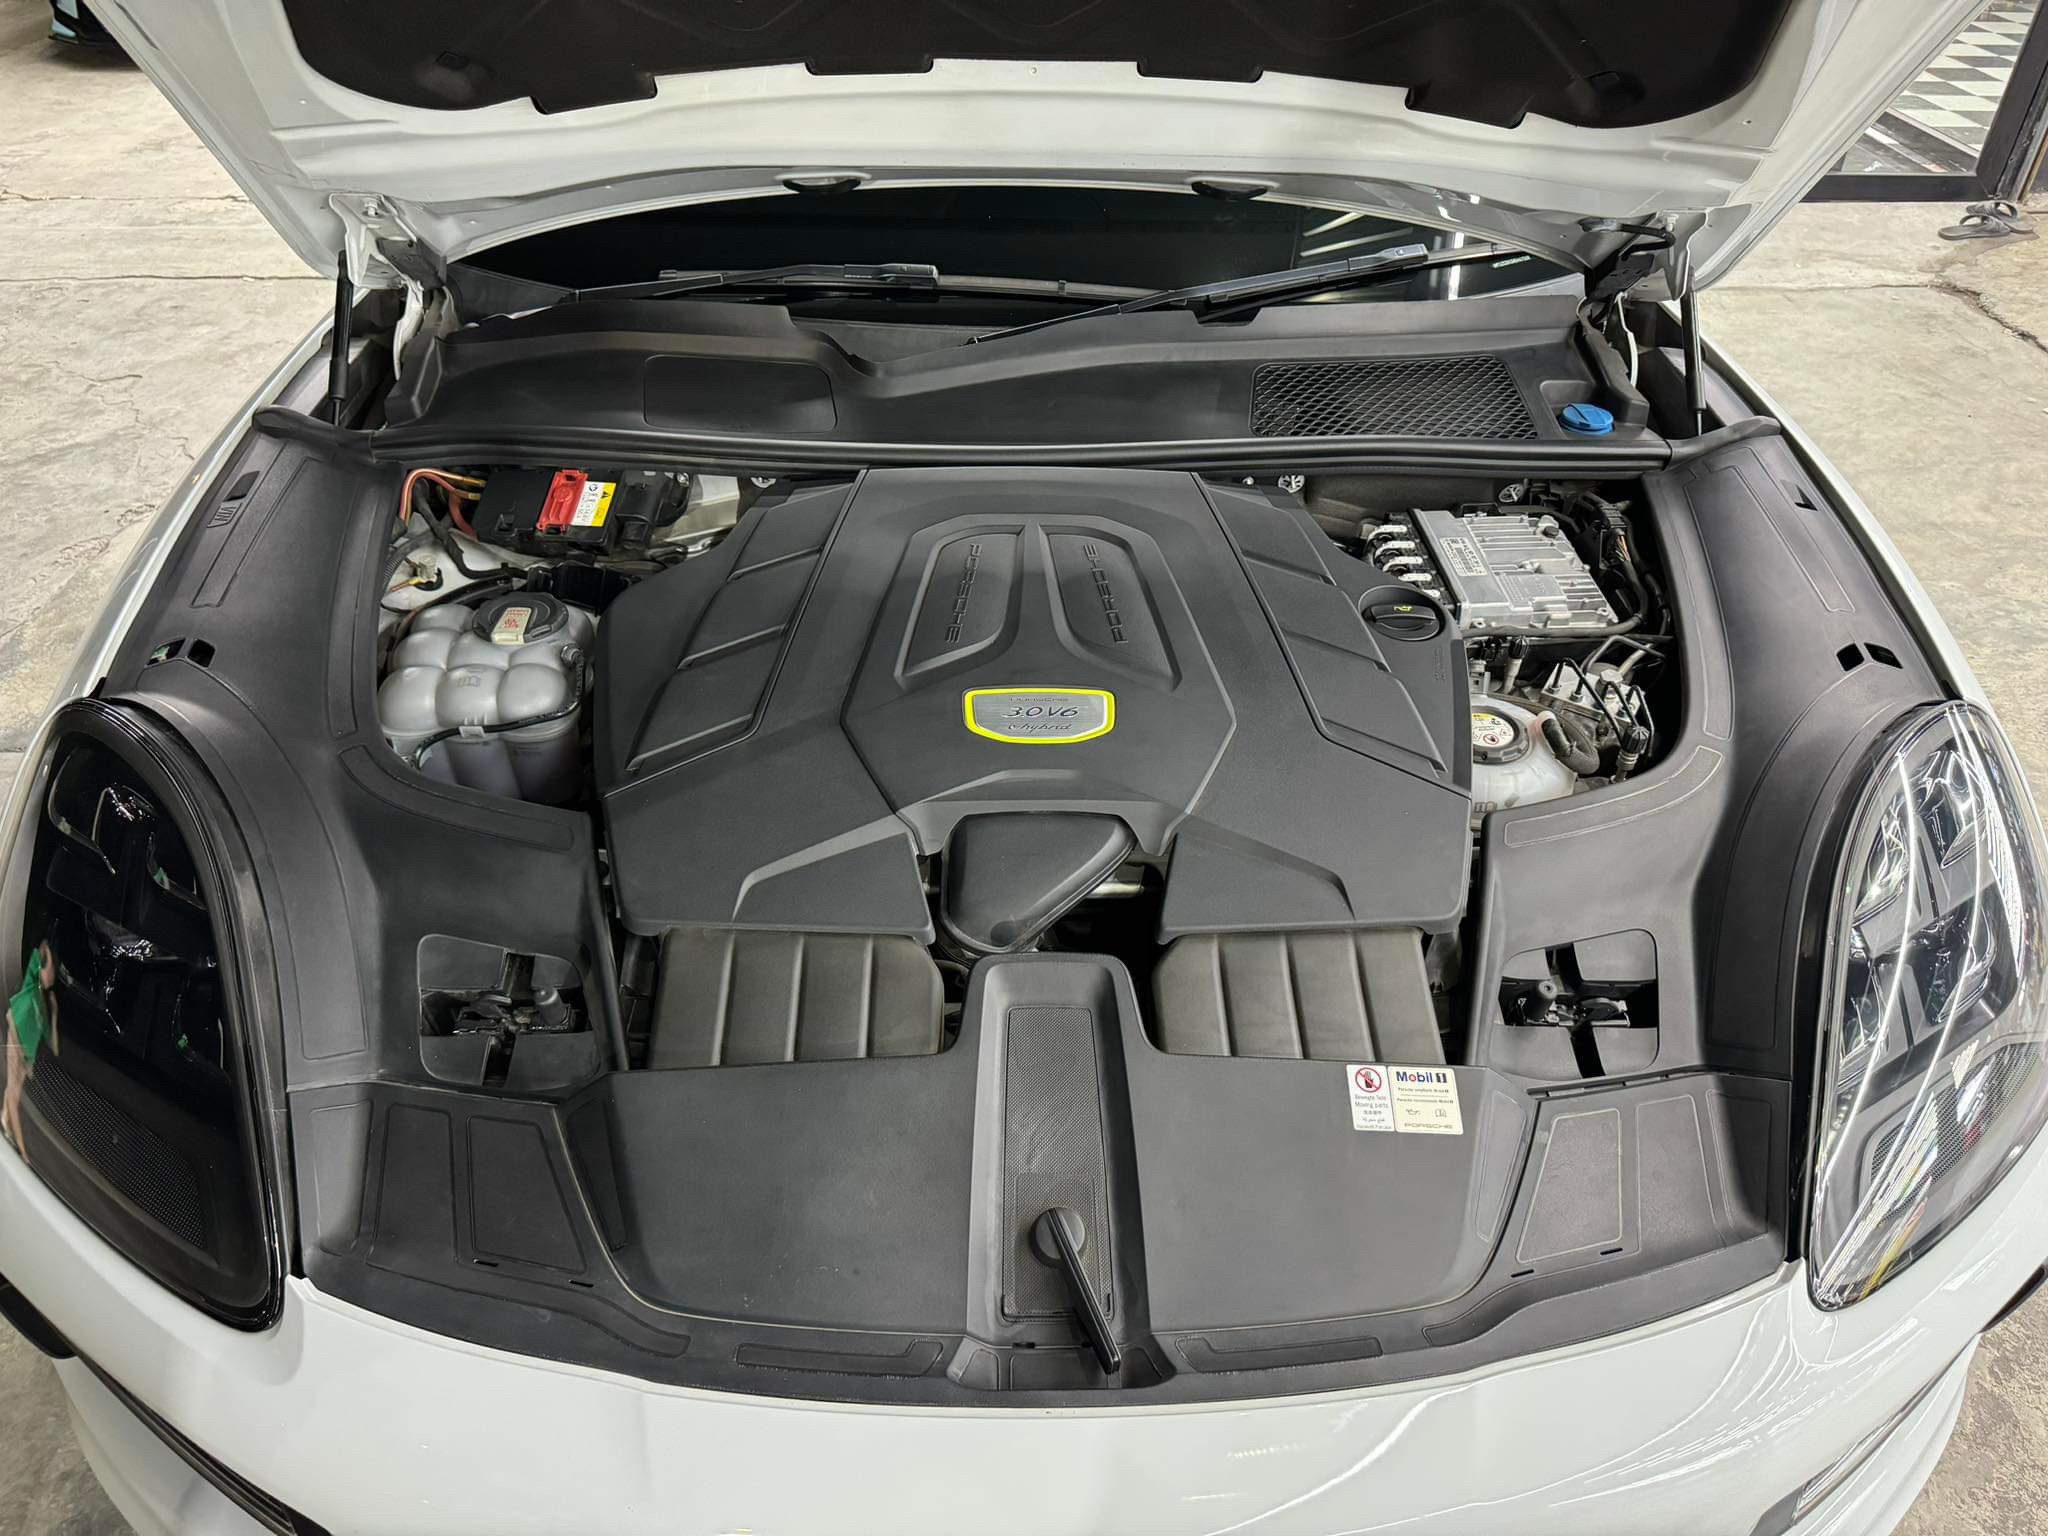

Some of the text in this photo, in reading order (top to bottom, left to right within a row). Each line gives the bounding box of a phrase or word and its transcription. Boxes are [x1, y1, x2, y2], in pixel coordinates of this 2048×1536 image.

[945, 543, 982, 643] PORSCHE
[1083, 543, 1129, 644] PORSCHE
[1396, 1071, 1433, 1083] Mobil
